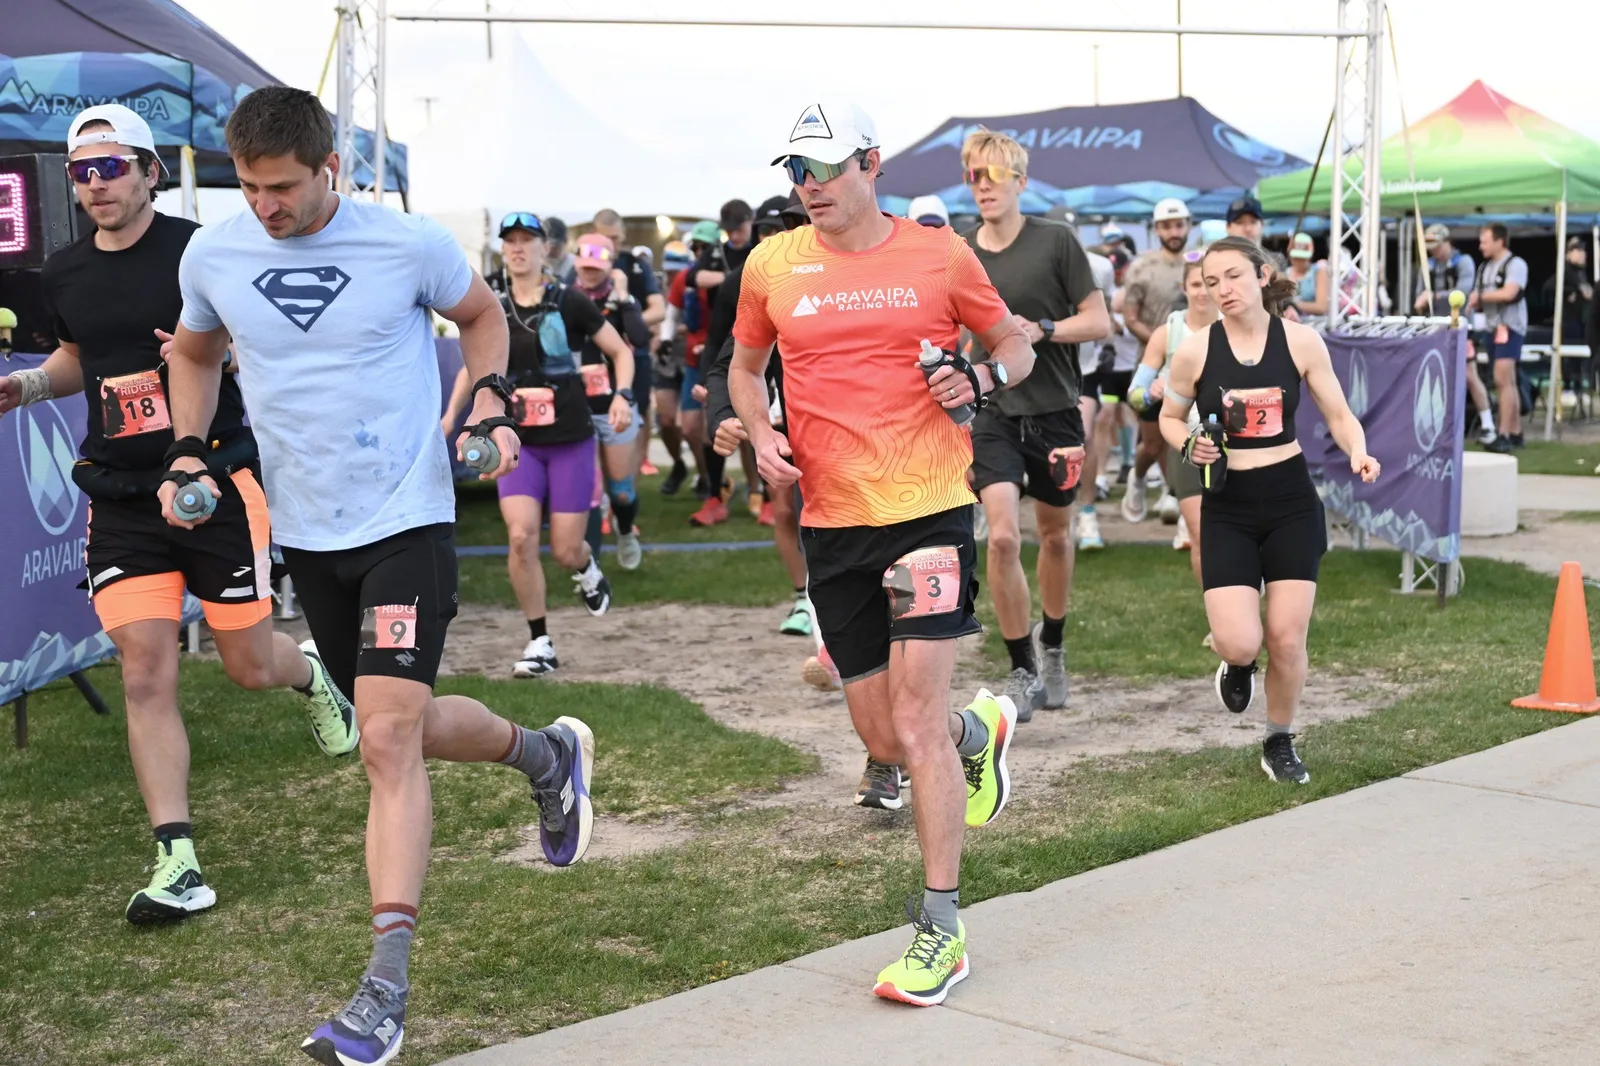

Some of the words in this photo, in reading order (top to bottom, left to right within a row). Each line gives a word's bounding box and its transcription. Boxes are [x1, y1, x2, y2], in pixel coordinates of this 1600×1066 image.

[791, 264, 824, 274] HOKA
[821, 287, 917, 306] ARAVAIPA
[838, 302, 883, 312] RACING
[888, 300, 918, 308] TEAM
[121, 382, 156, 396] RIDGE
[1249, 396, 1278, 406] RIDGE
[125, 397, 156, 420] 18
[1256, 410, 1267, 425] 2
[915, 559, 954, 571] RIDGE
[926, 575, 942, 598] 3
[389, 620, 407, 645] 9
